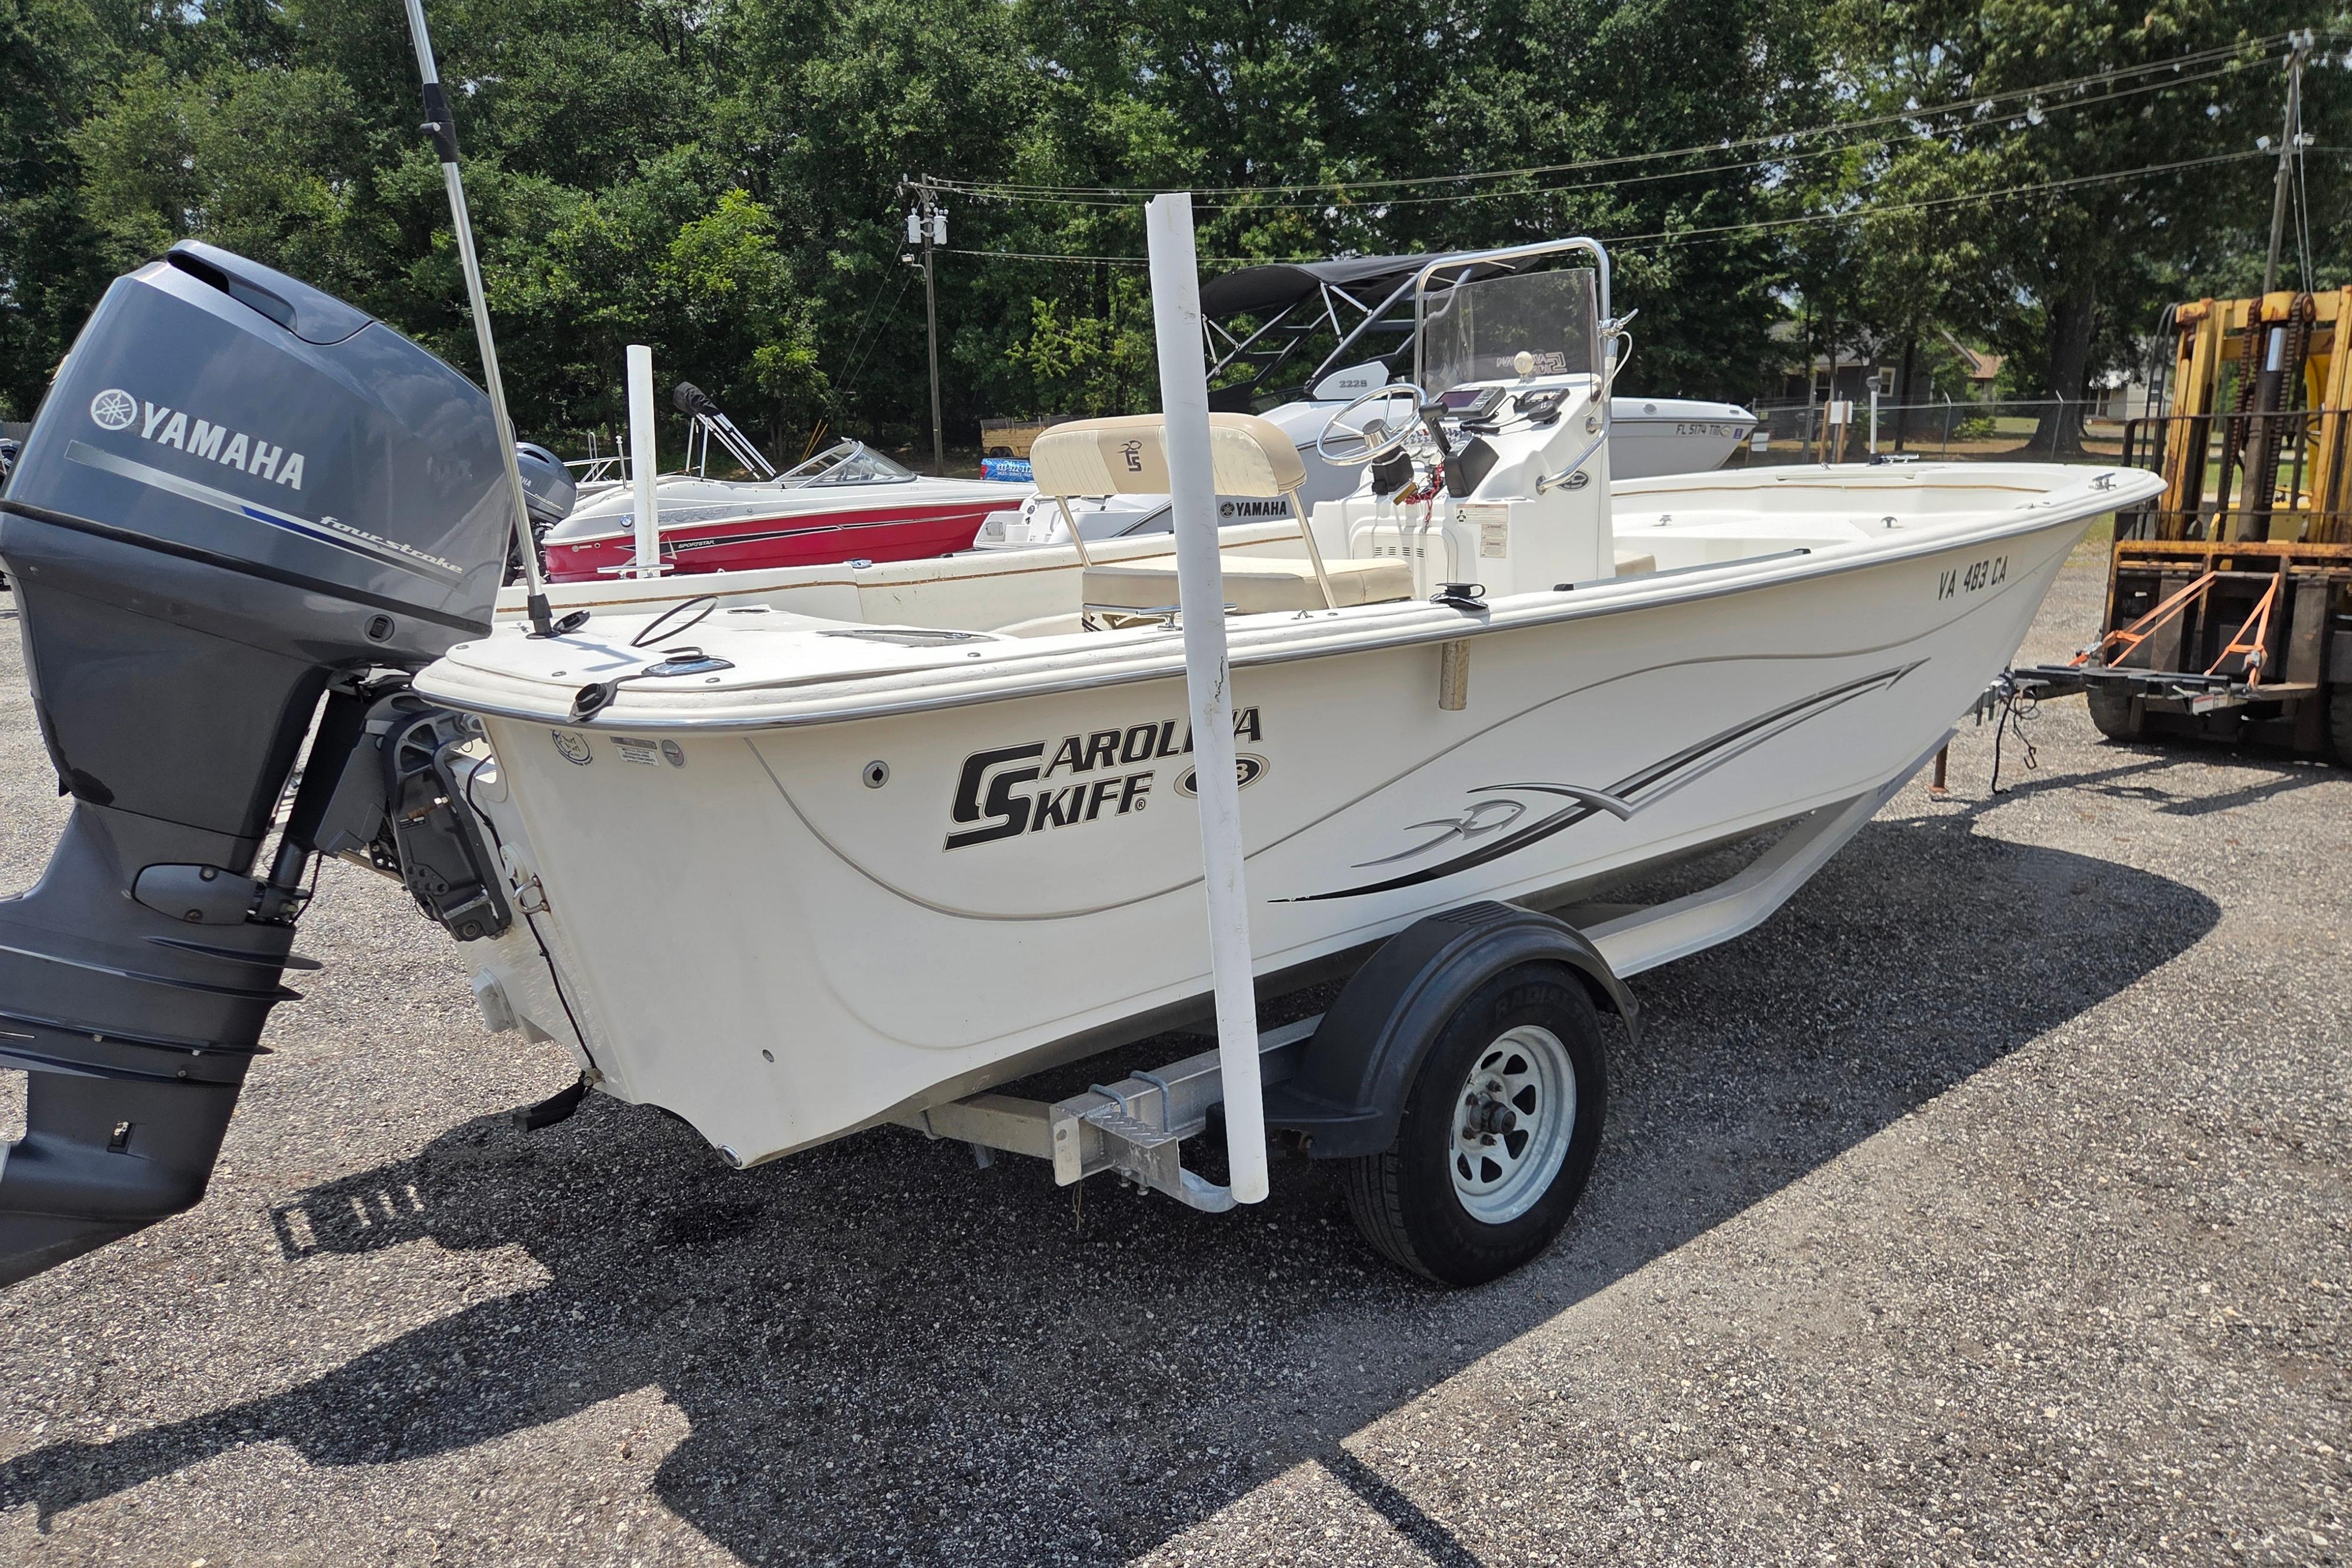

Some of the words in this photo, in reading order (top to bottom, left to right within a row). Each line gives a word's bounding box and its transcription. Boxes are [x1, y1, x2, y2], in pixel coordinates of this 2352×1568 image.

[141, 402, 306, 491] YAMAHA
[1236, 501, 1287, 516] YAMAHA
[679, 540, 715, 549] SPORTSTAR
[1939, 569, 1957, 600] VA
[1964, 560, 1989, 593] 483
[1991, 555, 2007, 586] CA
[951, 706, 1262, 823] CAROLIA
